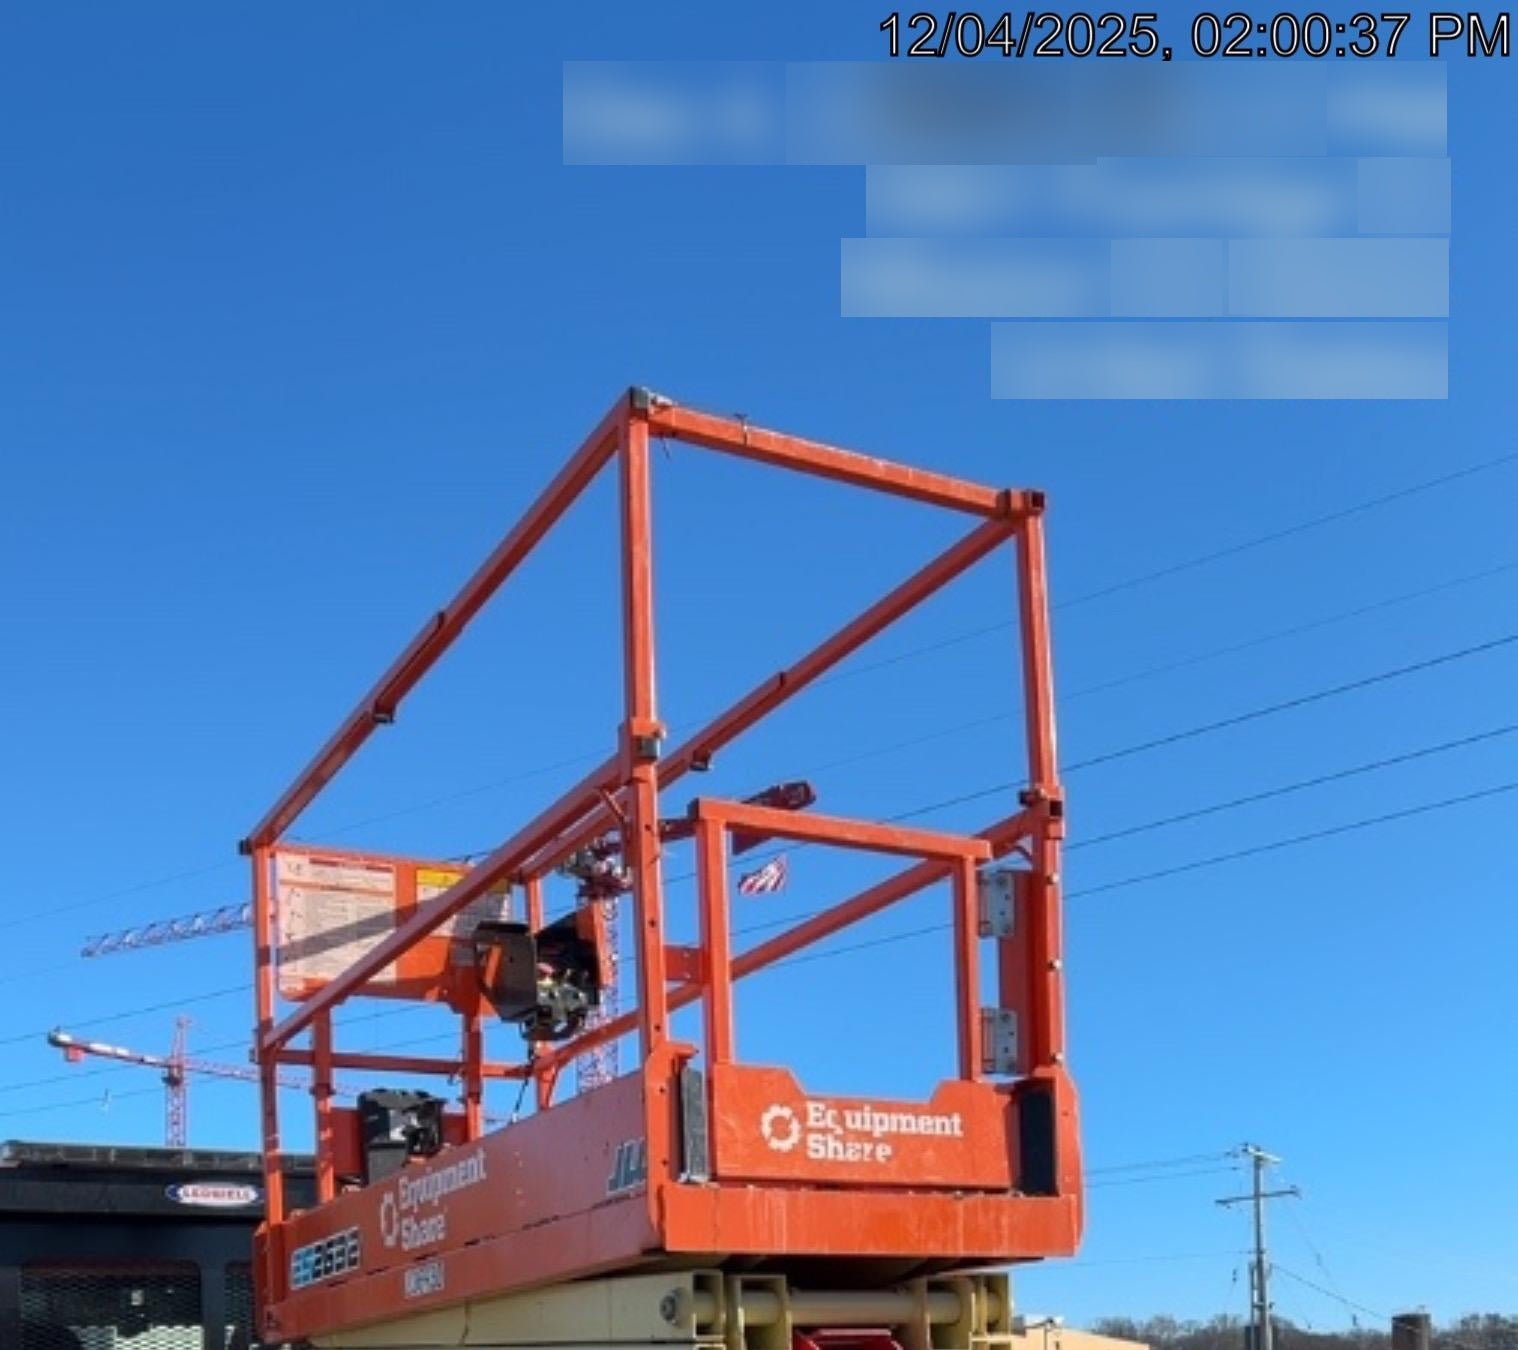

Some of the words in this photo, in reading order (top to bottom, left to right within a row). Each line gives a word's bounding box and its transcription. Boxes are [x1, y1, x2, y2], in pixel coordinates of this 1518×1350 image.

[806, 1101, 964, 1139] Equipment
[806, 1133, 892, 1163] Share
[399, 1147, 487, 1213] Equipment
[401, 1213, 447, 1252] Share
